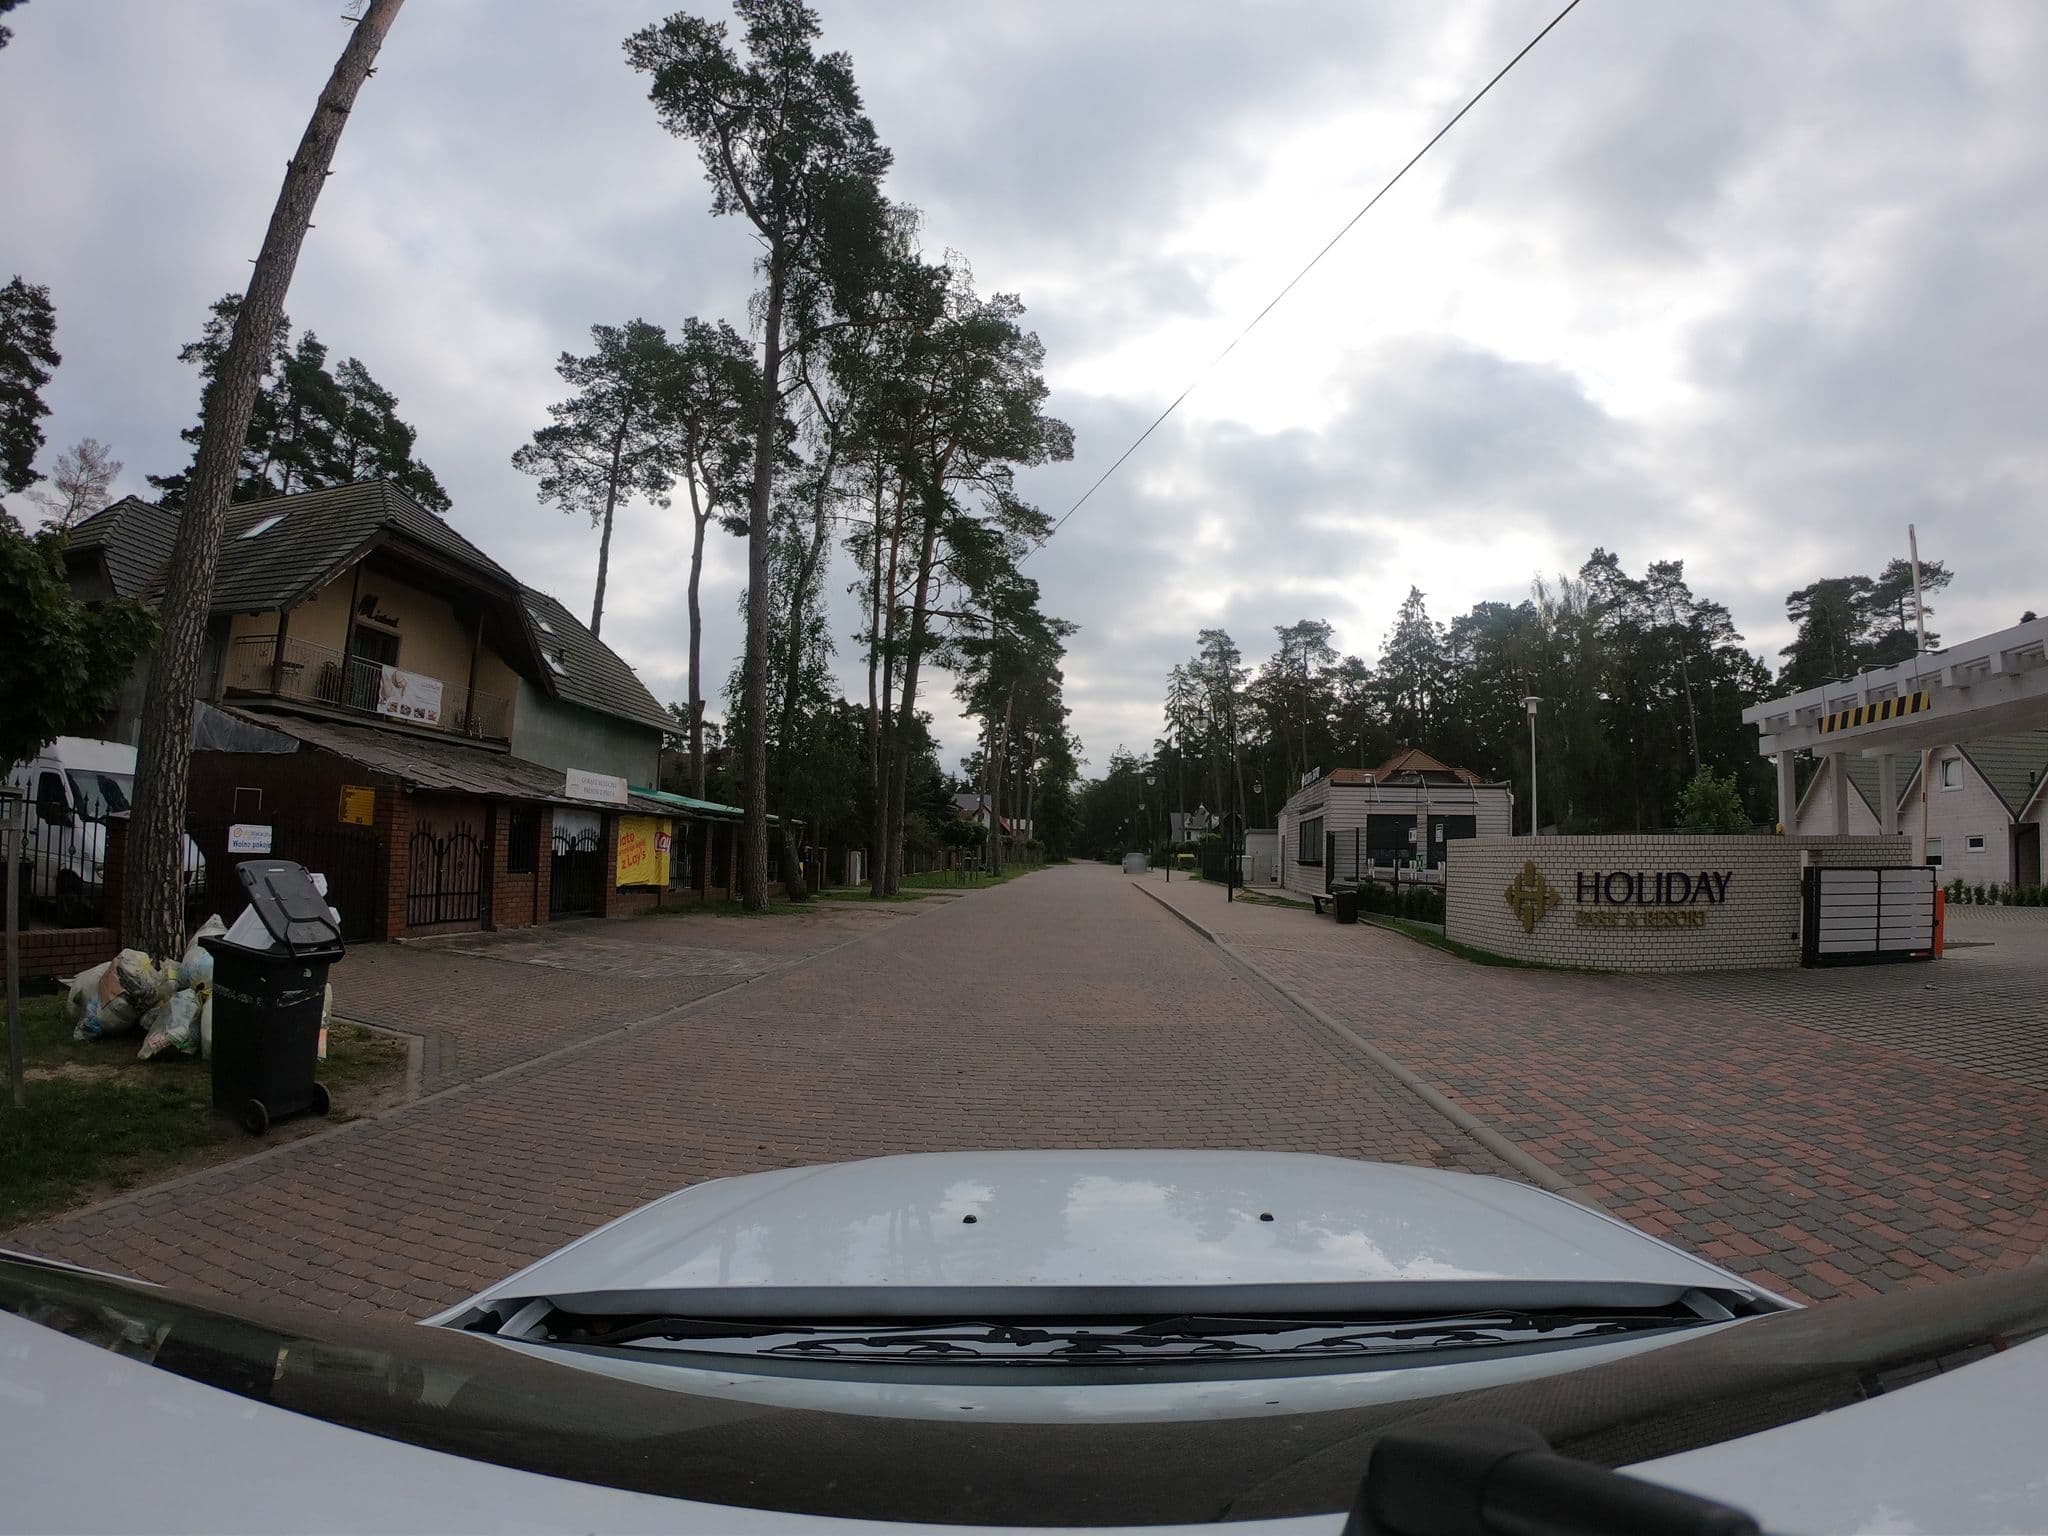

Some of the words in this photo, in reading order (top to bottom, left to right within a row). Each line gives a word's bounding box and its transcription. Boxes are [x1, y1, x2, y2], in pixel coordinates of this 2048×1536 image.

[627, 849, 646, 866] Lay's
[1576, 871, 1733, 904] HOLIDAY
[1575, 909, 1618, 927] PARK
[1626, 910, 1638, 928] &
[1645, 909, 1706, 928] RESORT
